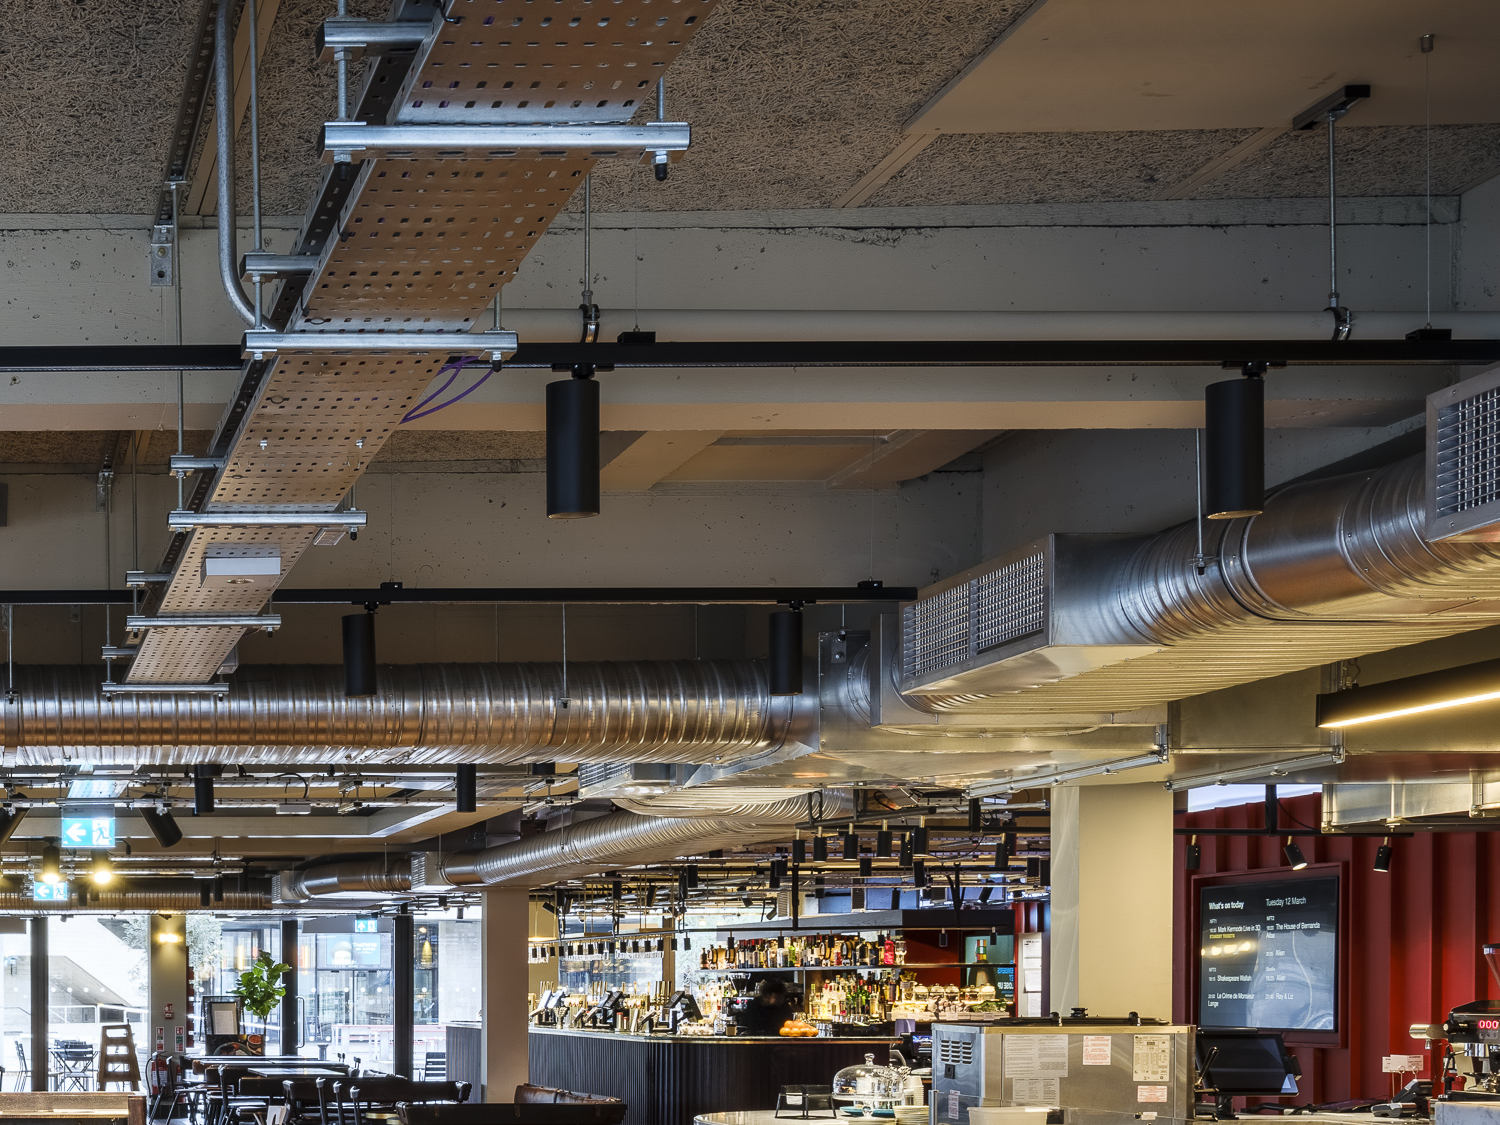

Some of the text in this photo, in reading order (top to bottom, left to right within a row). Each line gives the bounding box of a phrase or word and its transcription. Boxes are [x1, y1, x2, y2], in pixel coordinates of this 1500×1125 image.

[1209, 902, 1224, 910] What's
[1231, 901, 1244, 909] today
[1266, 896, 1306, 907] Tuesday 12 March
[1208, 1000, 1219, 1008] Lange
